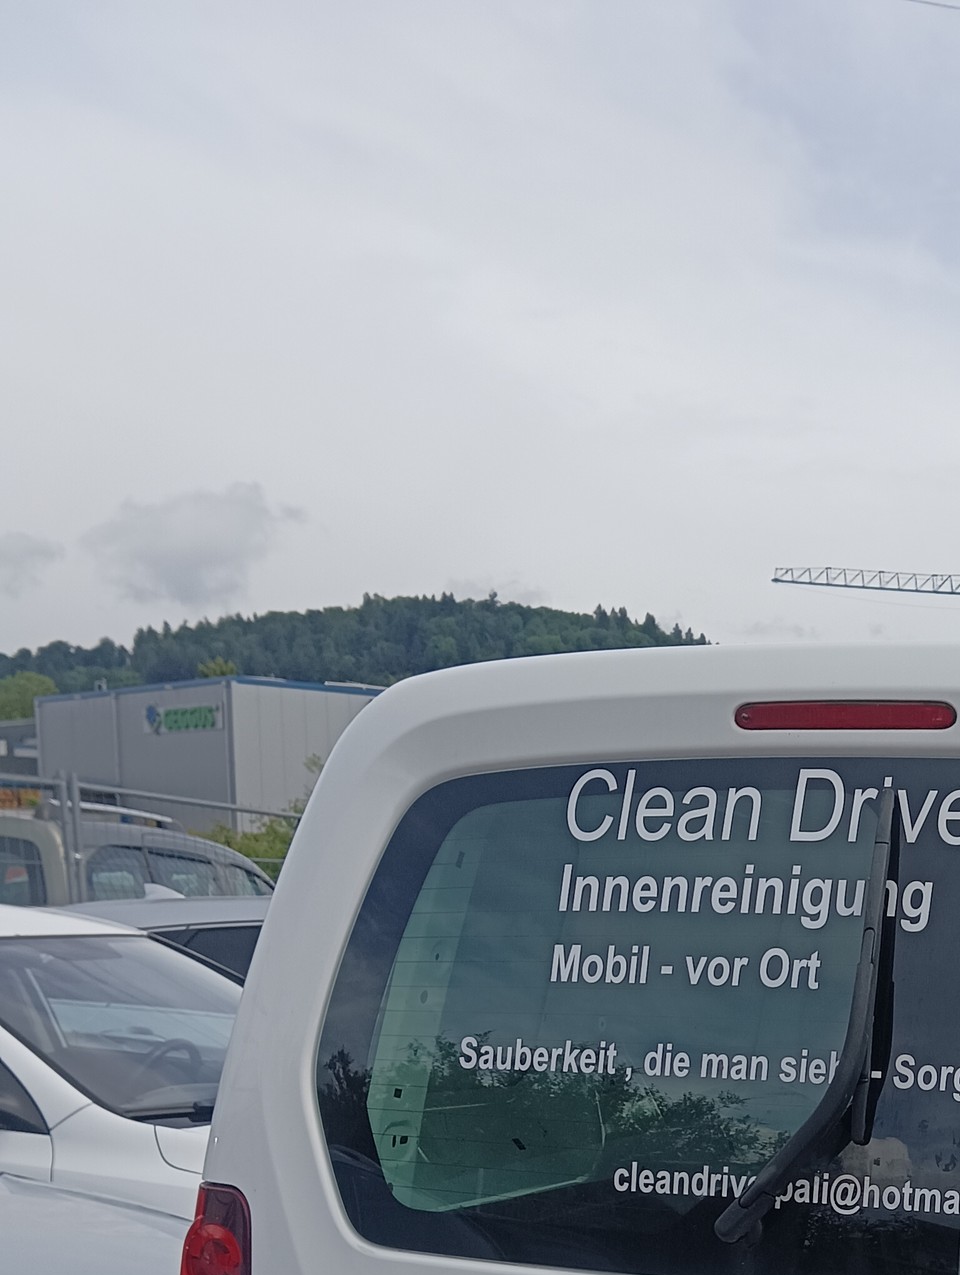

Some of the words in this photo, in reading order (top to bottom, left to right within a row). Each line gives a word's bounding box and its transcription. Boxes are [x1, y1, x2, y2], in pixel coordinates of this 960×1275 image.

[567, 768, 763, 842] Clean
[550, 944, 650, 984] Mobil
[660, 965, 674, 975] -
[685, 955, 749, 987] vor
[759, 947, 821, 990] Ort
[643, 1043, 691, 1079] die
[700, 1053, 769, 1082] man
[871, 1070, 883, 1079] -
